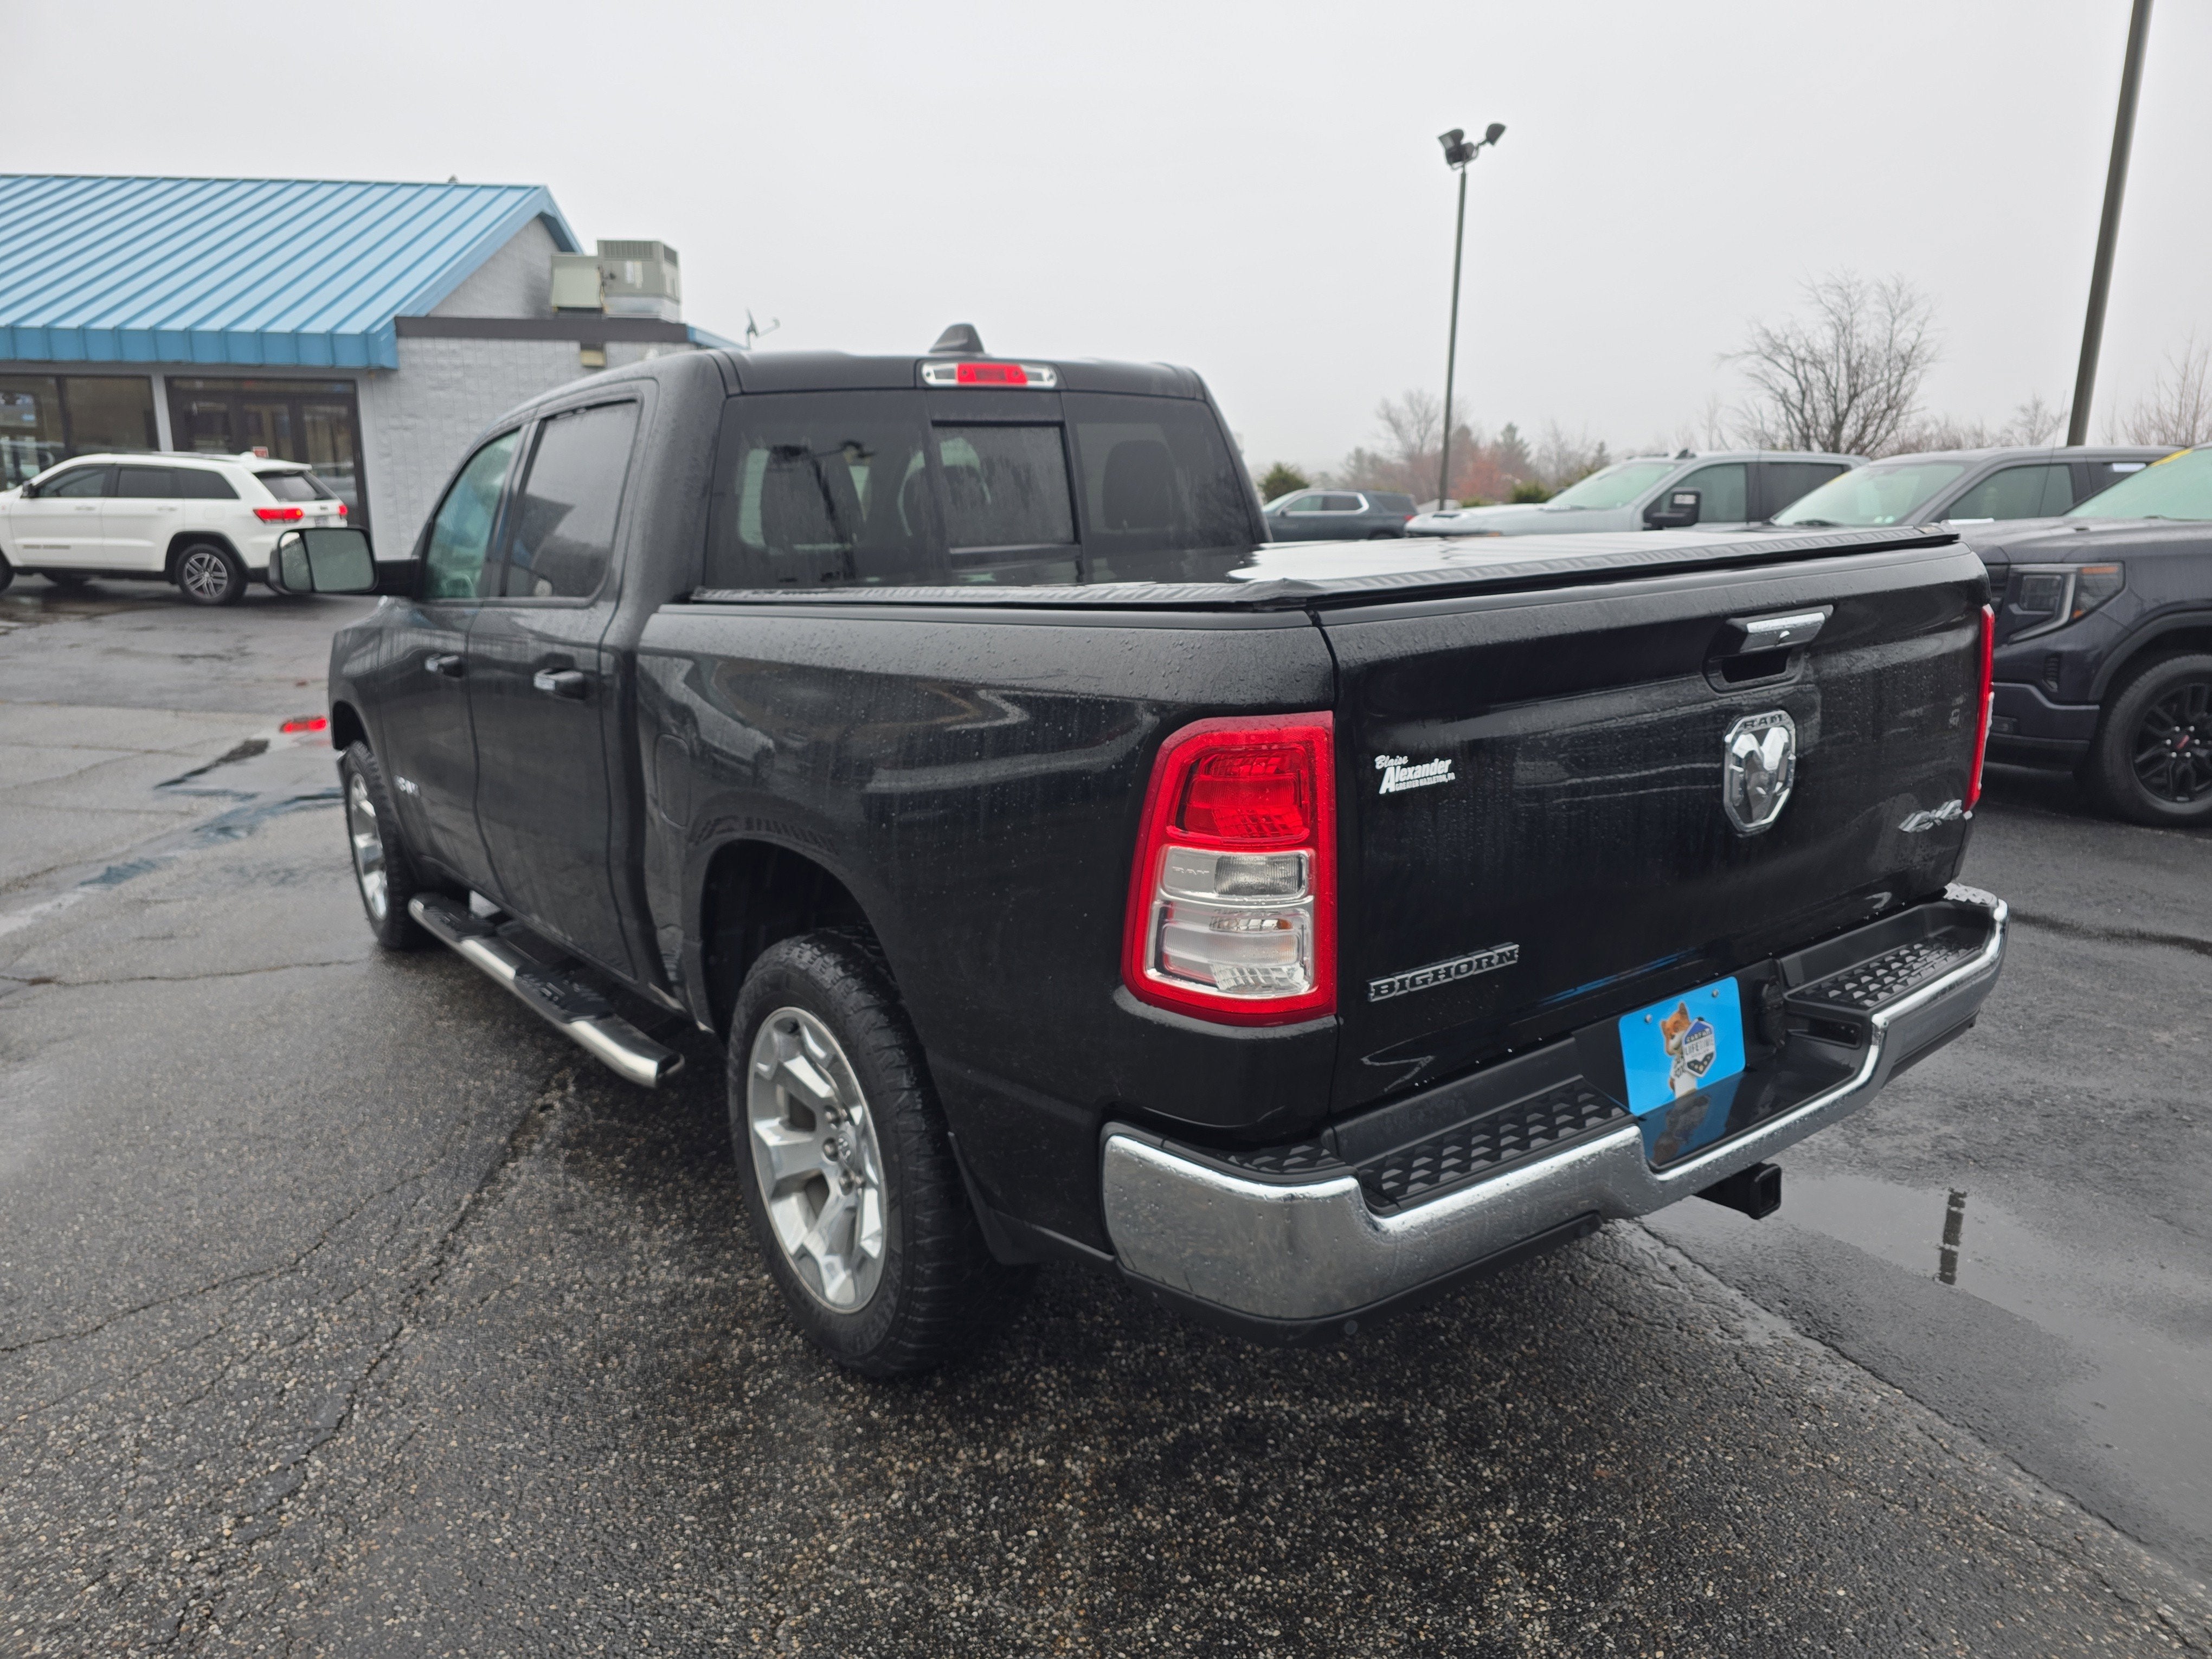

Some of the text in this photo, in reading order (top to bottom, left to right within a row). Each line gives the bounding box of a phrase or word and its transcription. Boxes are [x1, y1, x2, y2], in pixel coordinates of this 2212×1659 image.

[1744, 713, 1783, 730] RAM
[1374, 755, 1409, 769] Blaise
[1379, 758, 1452, 794] Alexander
